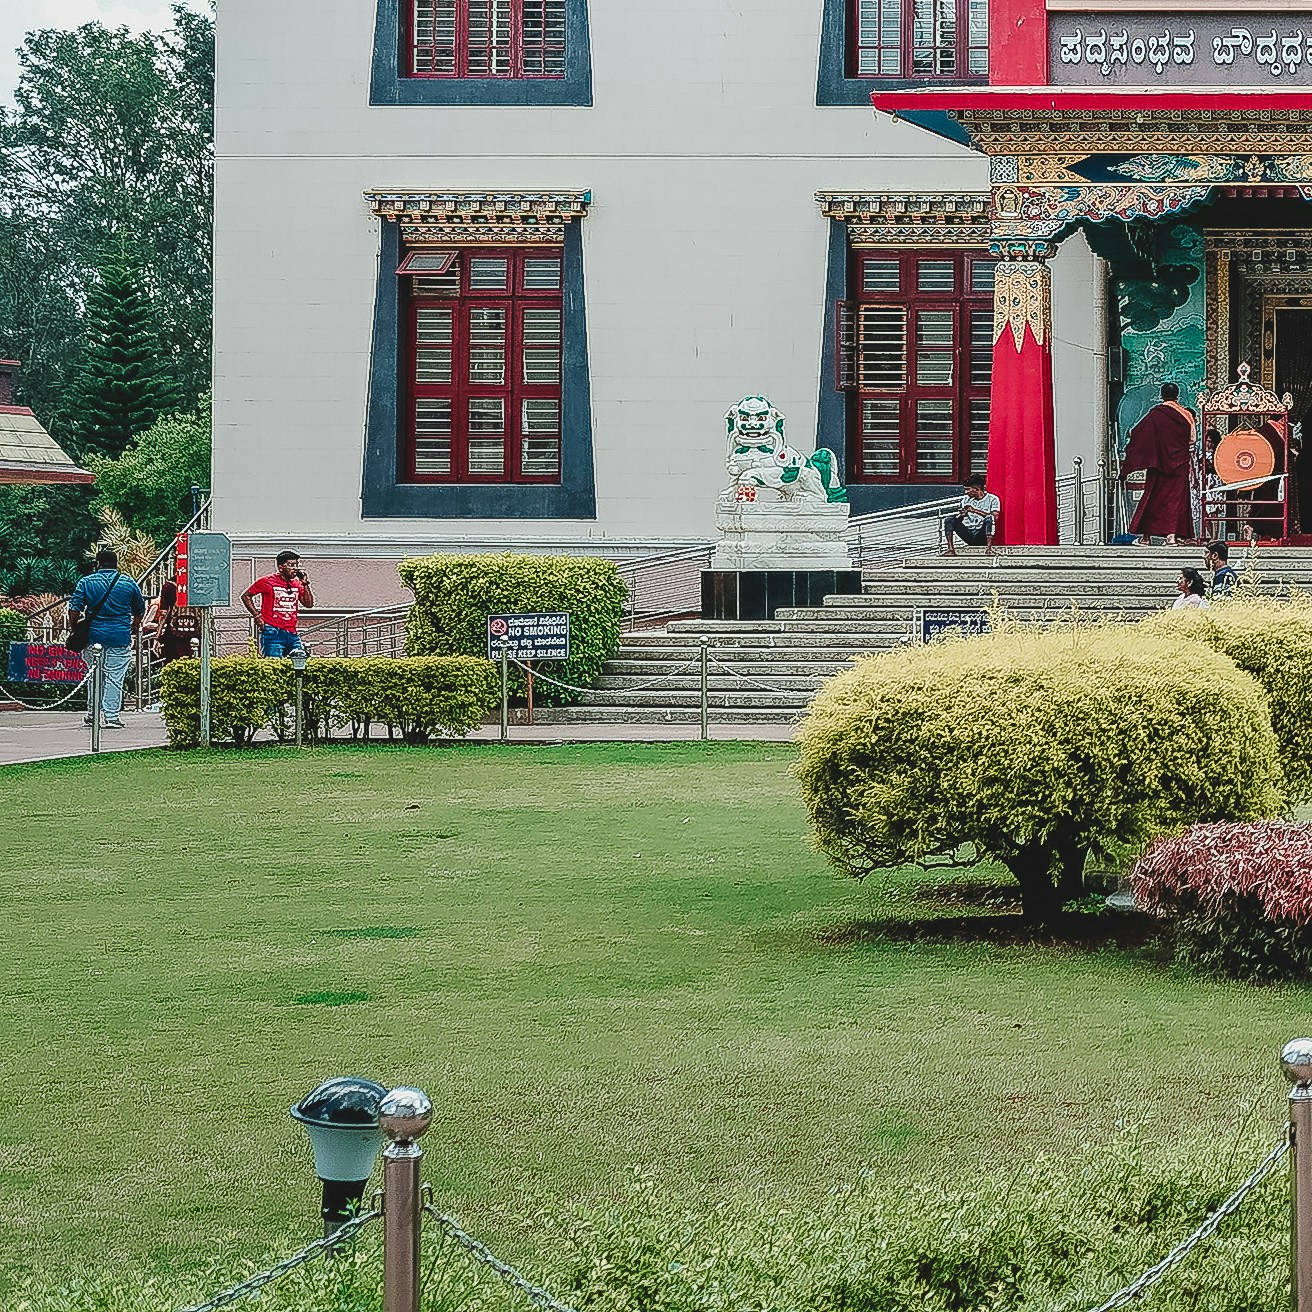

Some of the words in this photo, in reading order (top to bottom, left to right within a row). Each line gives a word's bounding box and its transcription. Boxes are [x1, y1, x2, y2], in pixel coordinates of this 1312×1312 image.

[508, 627, 522, 636] NO
[523, 626, 567, 635] SMOKING
[518, 649, 535, 657] KEEP
[536, 648, 566, 657] SILENCE
